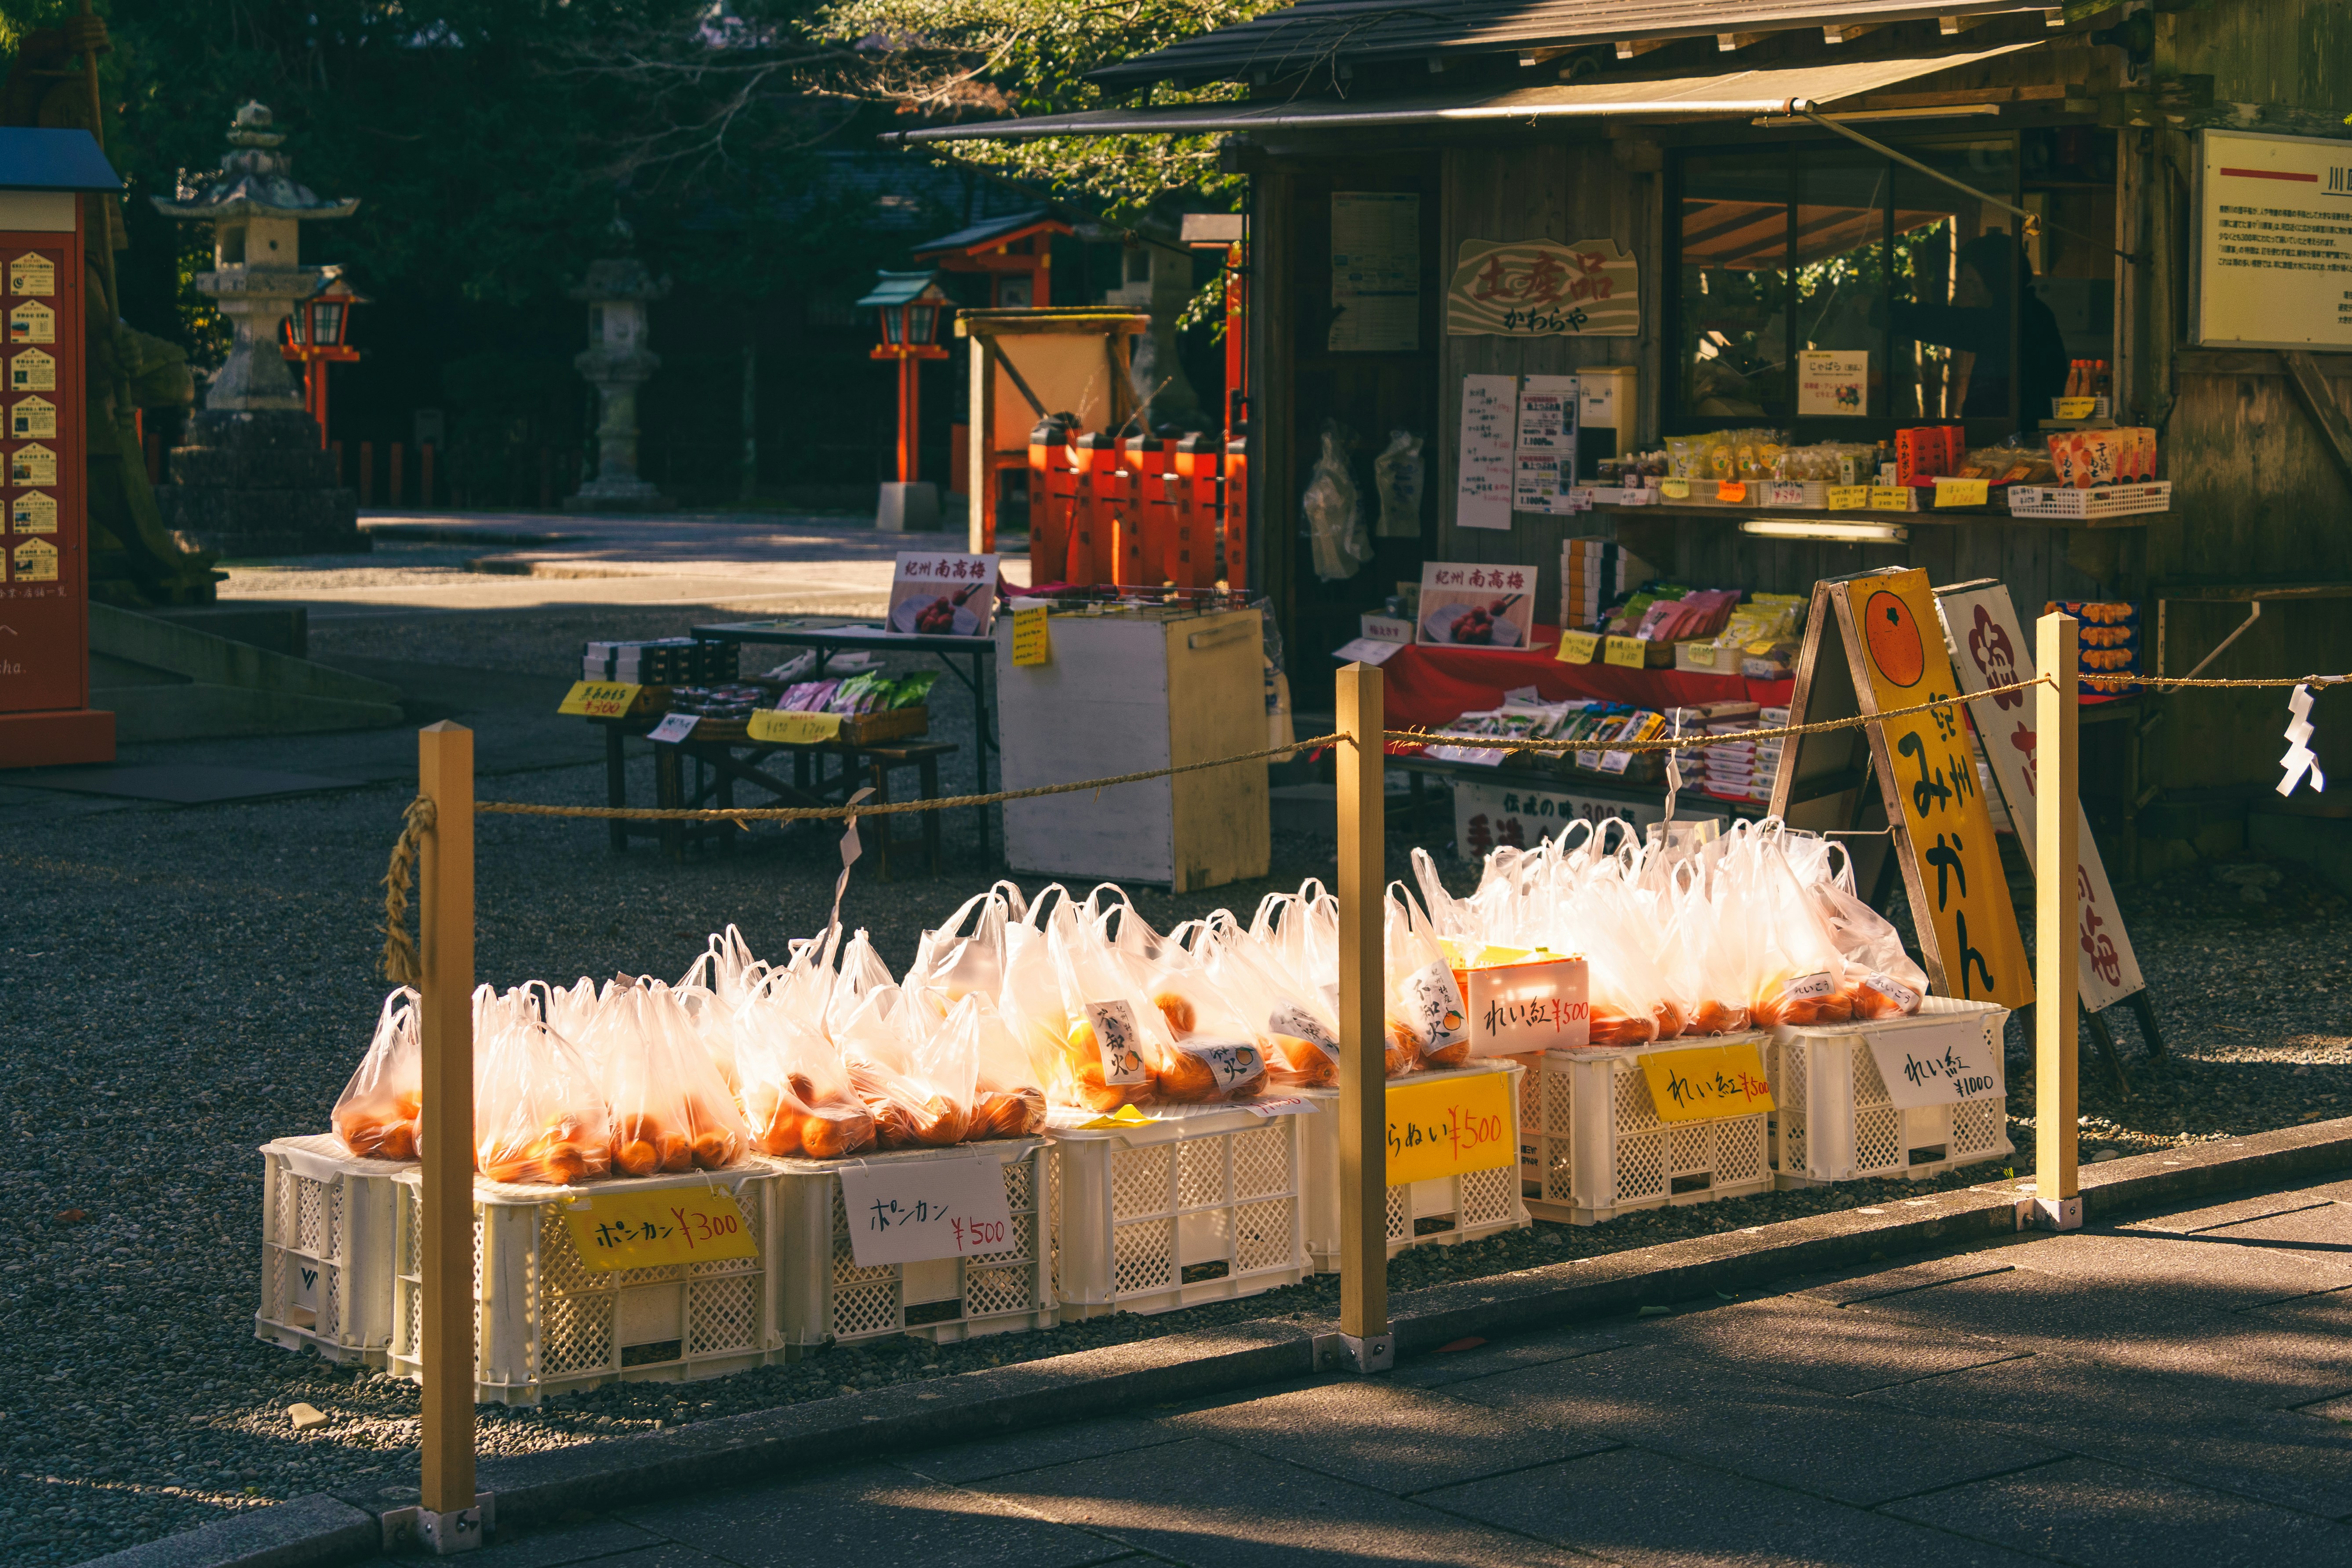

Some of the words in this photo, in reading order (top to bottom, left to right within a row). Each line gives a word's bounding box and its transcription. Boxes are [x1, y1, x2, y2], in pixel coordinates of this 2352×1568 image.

[1473, 251, 1613, 302] 土産品
[1504, 307, 1588, 332] かわらや
[0, 659, 26, 675] ha.
[1898, 731, 1994, 1001] みかん
[1431, 968, 1452, 1003] 紀州特産
[1794, 980, 1830, 995] れいこう
[1875, 979, 1912, 1004] れいこう
[1484, 996, 1552, 1037] れい紅
[1552, 998, 1589, 1033] ¥500
[1097, 1008, 1129, 1077] 不知火
[1666, 1069, 1742, 1109] れい紅
[1741, 1072, 1770, 1103] ¥500
[1905, 1046, 1971, 1087] れい紅
[1953, 1075, 1994, 1098] ¥1000
[1448, 1104, 1501, 1162] ¥500
[594, 1221, 672, 1249] ポンカン
[670, 1207, 739, 1250] ¥300
[870, 1198, 949, 1232] ポンカン
[951, 1216, 1006, 1251] ¥500
